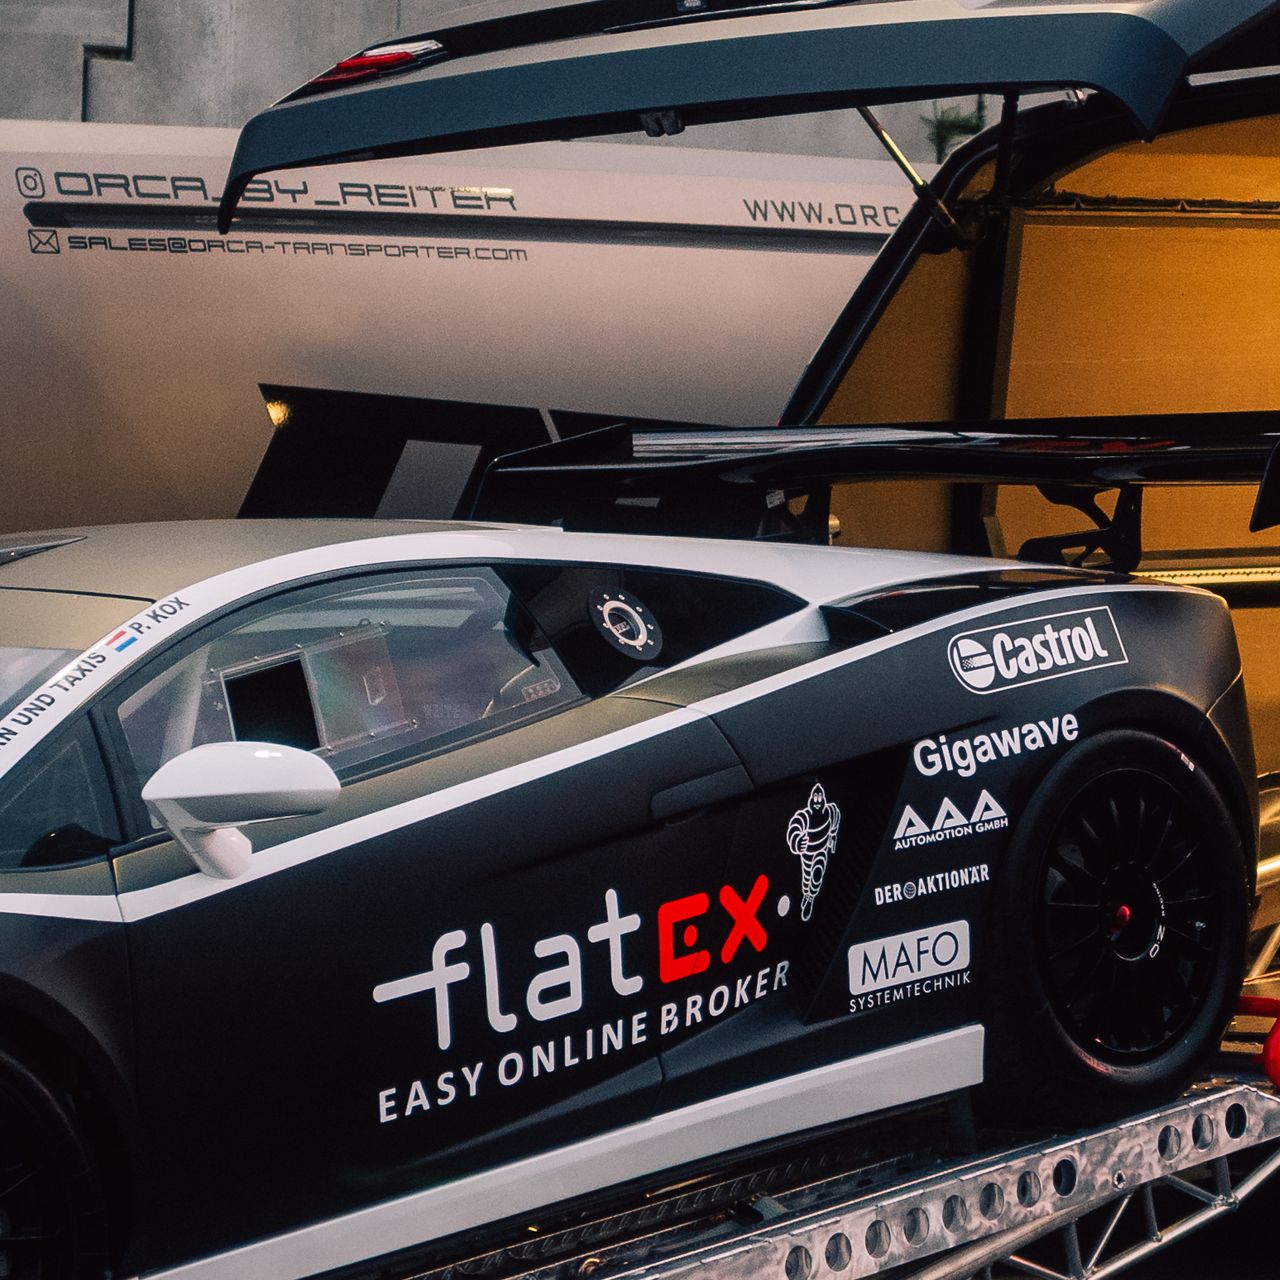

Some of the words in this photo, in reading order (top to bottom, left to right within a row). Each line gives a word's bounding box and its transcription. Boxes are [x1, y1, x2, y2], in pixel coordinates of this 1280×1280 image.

[68, 236, 528, 261] SALES@ORCA-TRANSPORTER.COM
[128, 621, 152, 635] P.
[145, 596, 191, 624] KOX
[992, 616, 1109, 680] Castrol
[11, 693, 56, 726] UND
[49, 652, 106, 693] TAXIS
[914, 713, 1079, 778] Gigawave
[894, 825, 973, 851] AUTOMOTION
[975, 817, 1009, 834] GMBH
[874, 882, 903, 906] DER
[917, 863, 991, 897] AKTIONÄR
[861, 931, 959, 986] MAFO
[849, 970, 972, 1013] SYSTEMTECHNIK
[378, 1061, 484, 1123] EASY
[498, 1011, 648, 1087] ONLINE
[660, 959, 791, 1036] BROKER
